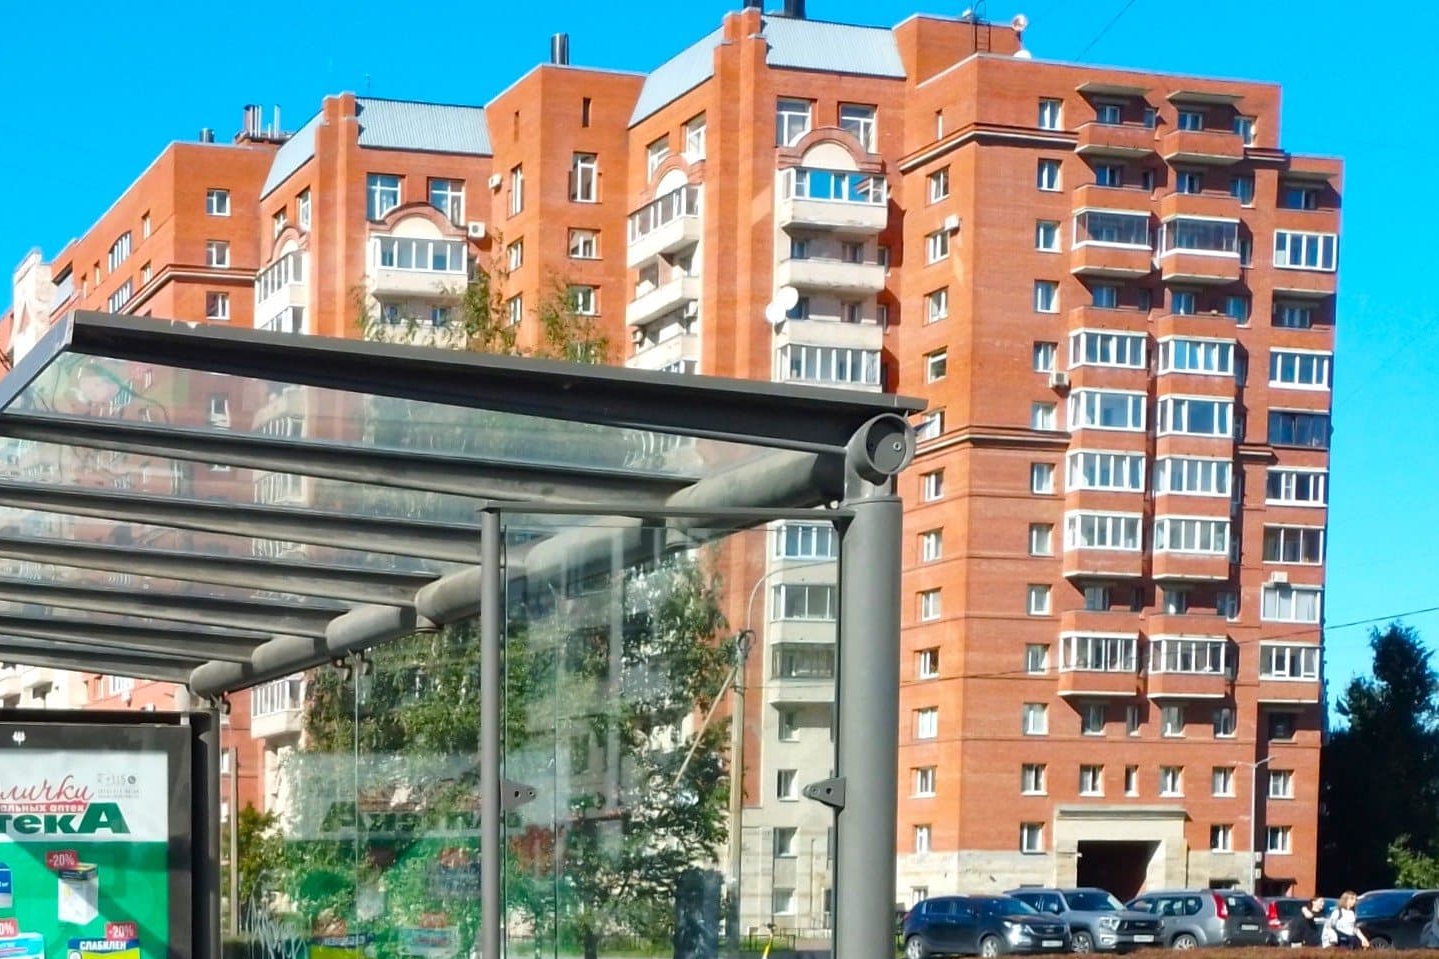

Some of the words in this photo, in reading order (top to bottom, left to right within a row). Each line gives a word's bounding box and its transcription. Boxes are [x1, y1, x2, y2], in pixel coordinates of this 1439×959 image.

[49, 853, 75, 868] -20%
[108, 924, 134, 939] -20%
[79, 940, 127, 951] СЛАБИЛЕН
